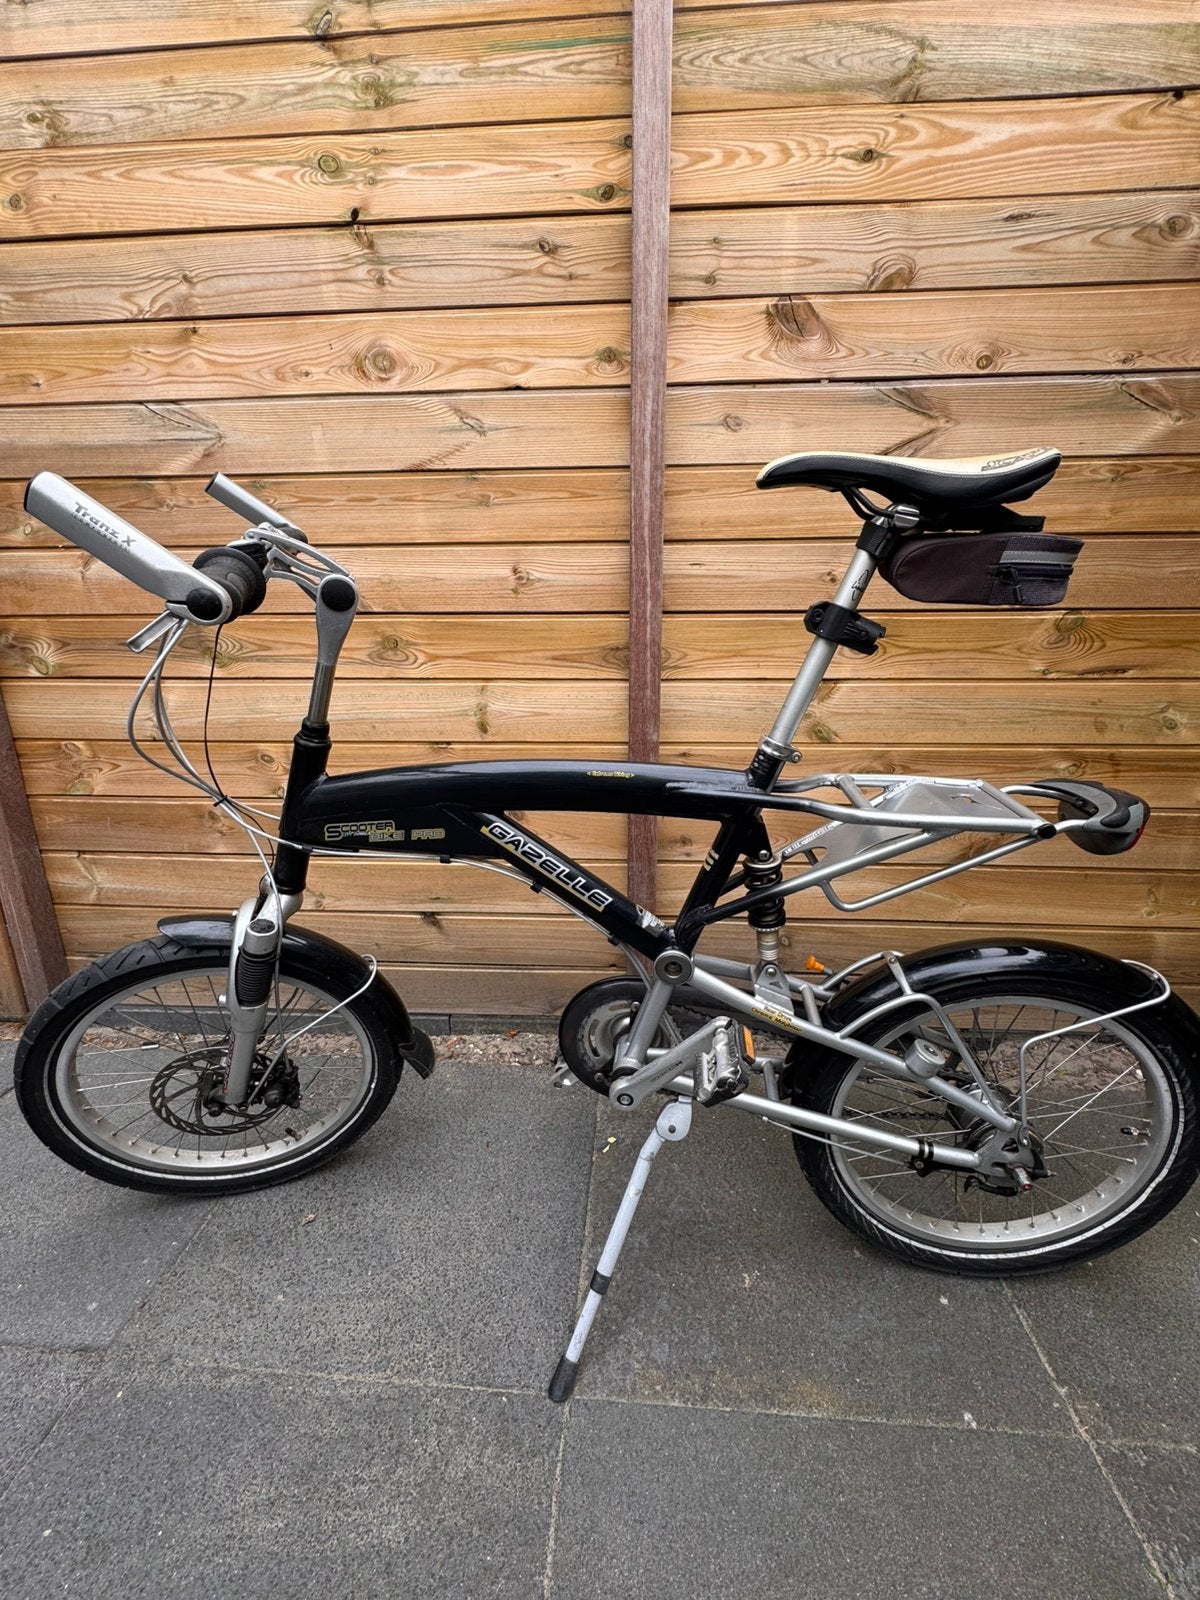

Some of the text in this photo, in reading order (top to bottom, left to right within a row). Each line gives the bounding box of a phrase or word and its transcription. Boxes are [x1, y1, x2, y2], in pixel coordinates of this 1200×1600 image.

[324, 820, 395, 841] SCOOTER
[369, 829, 405, 842] BIKE
[411, 828, 446, 840] PRO
[488, 822, 613, 908] GAZELLE
